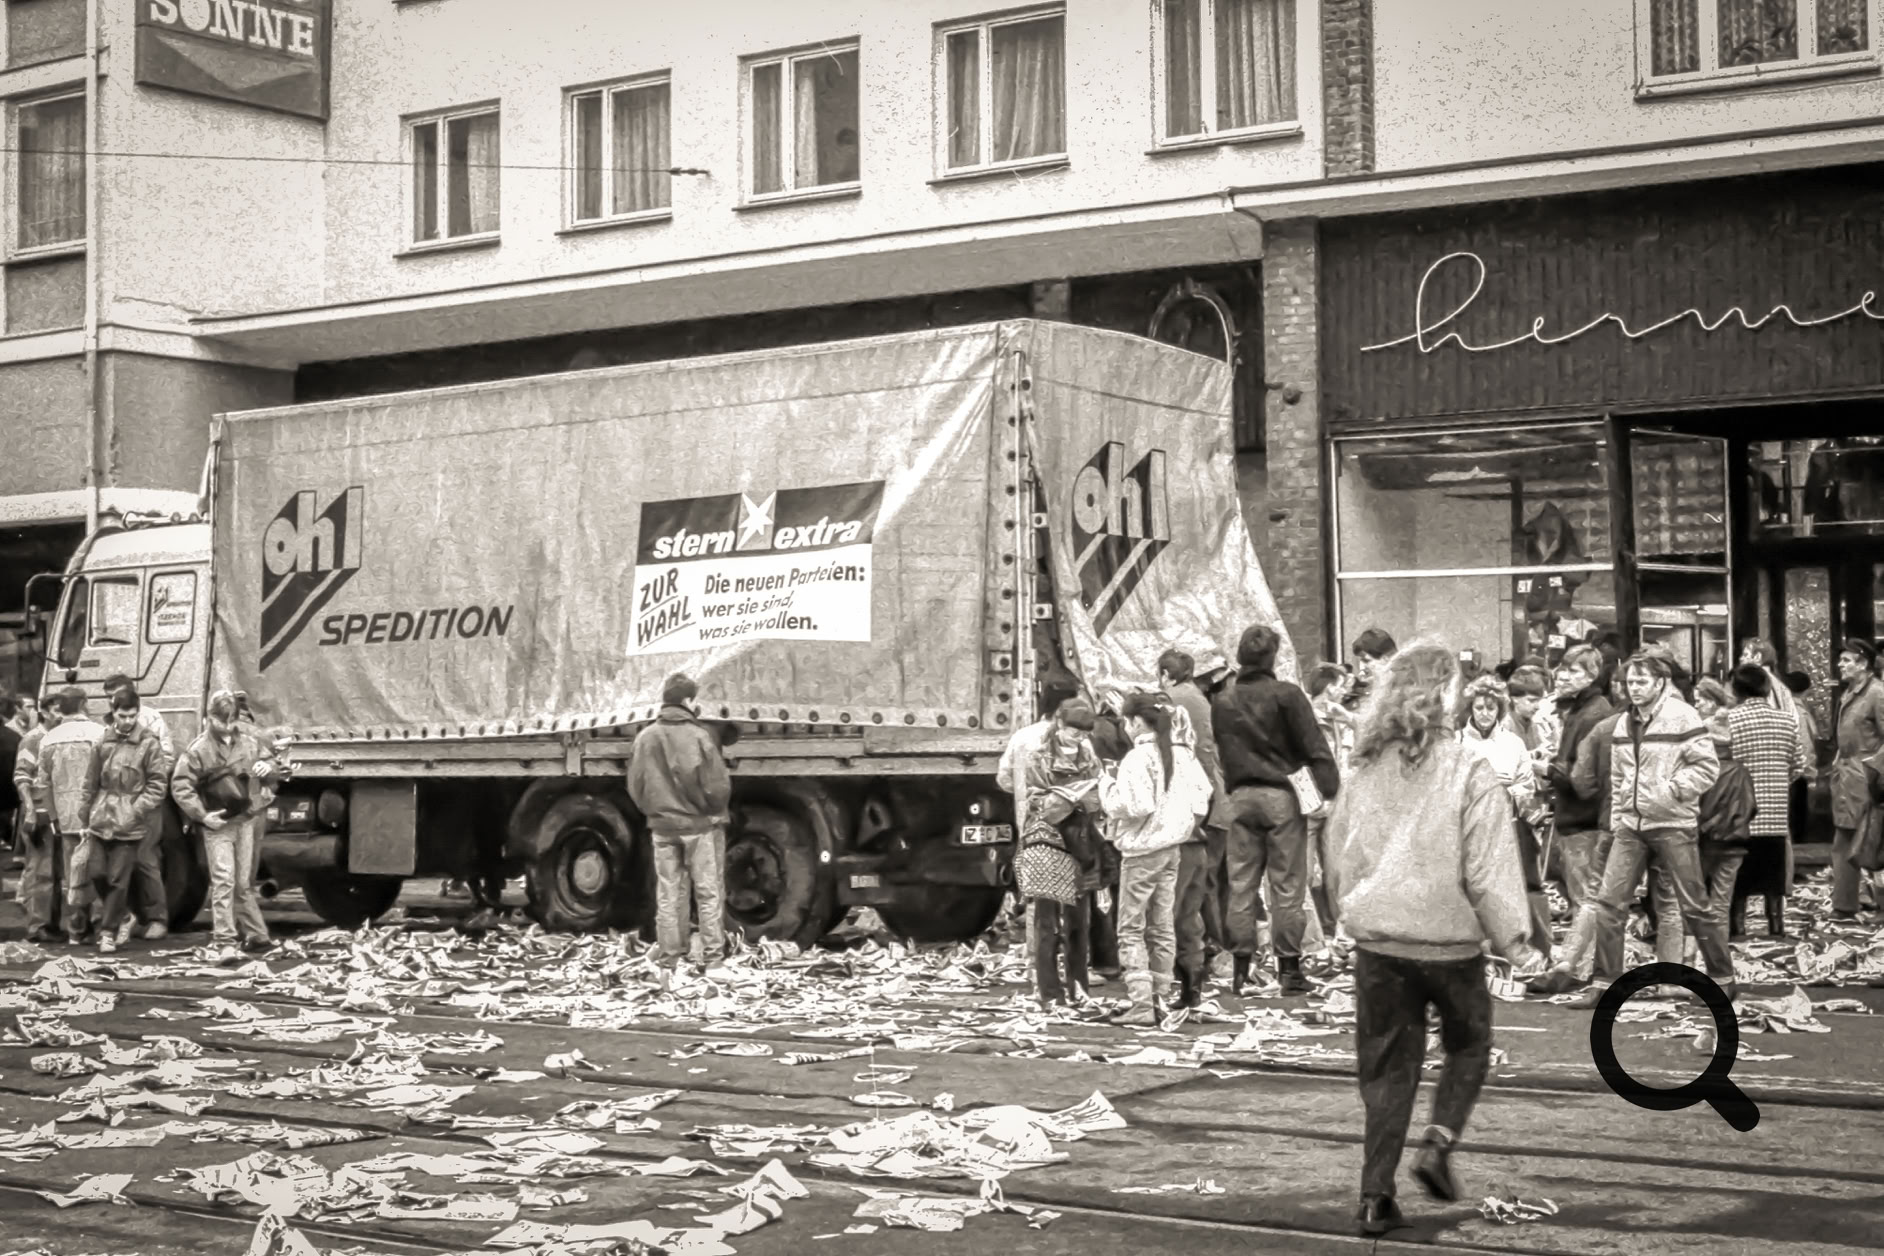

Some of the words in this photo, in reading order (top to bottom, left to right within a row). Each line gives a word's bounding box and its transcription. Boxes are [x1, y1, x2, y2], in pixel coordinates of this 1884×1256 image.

[151, 0, 314, 56] SONNE
[653, 528, 736, 559] stern
[774, 516, 862, 549] extra
[639, 568, 679, 612] ZUR
[704, 572, 730, 594] Die
[735, 573, 784, 593] neuen
[788, 560, 865, 588] Parteien:
[319, 605, 514, 646] SPEDITION
[637, 596, 691, 646] WAHL
[699, 625, 729, 640] was
[731, 620, 751, 635] sie
[754, 611, 818, 634] wollen.
[702, 601, 734, 618] wer
[736, 598, 759, 616] sie
[761, 591, 794, 611] sind,
